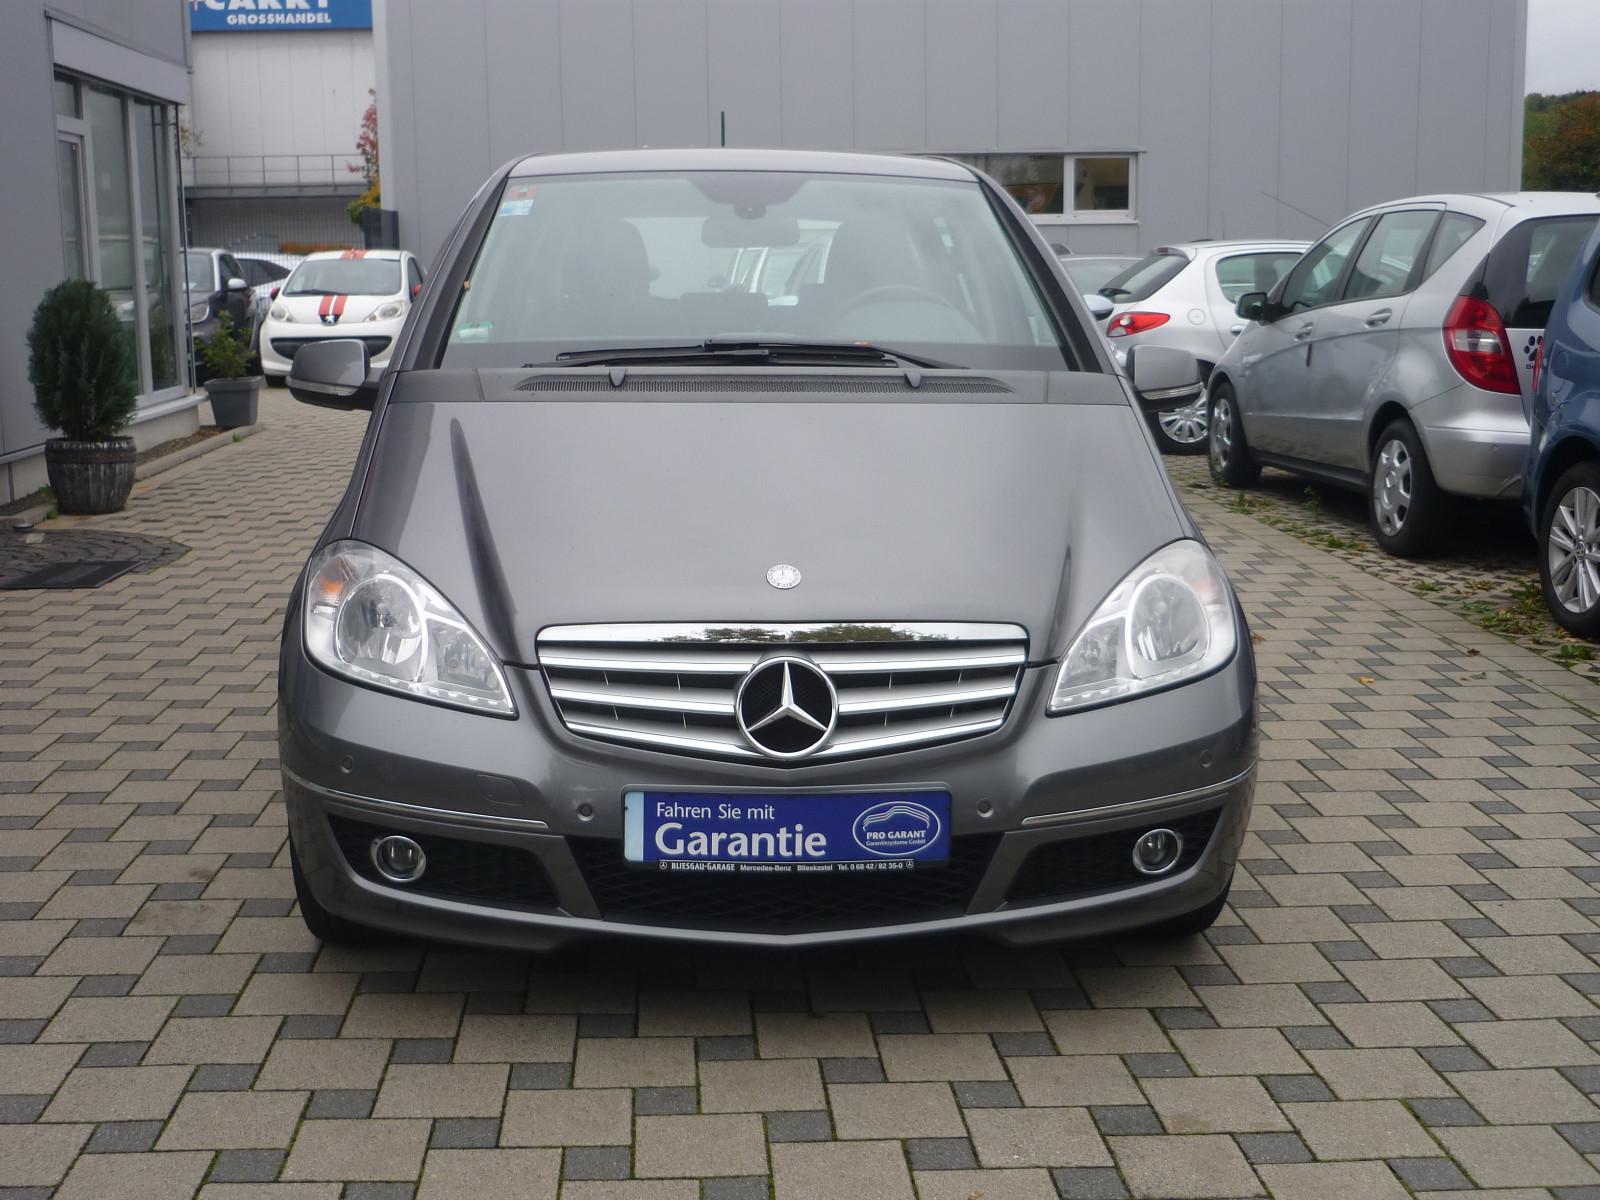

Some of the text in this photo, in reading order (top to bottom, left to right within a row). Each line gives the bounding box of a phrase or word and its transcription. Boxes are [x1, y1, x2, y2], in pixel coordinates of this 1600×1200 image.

[226, 12, 332, 25] GROSSHANDEL
[656, 802, 775, 820] Fahren Sie mit
[655, 822, 827, 857] Garantie
[866, 830, 926, 840] PRO GARANT
[671, 862, 736, 871] BLIESGAU-GARAGE
[740, 864, 792, 872] Mercedes-Benz
